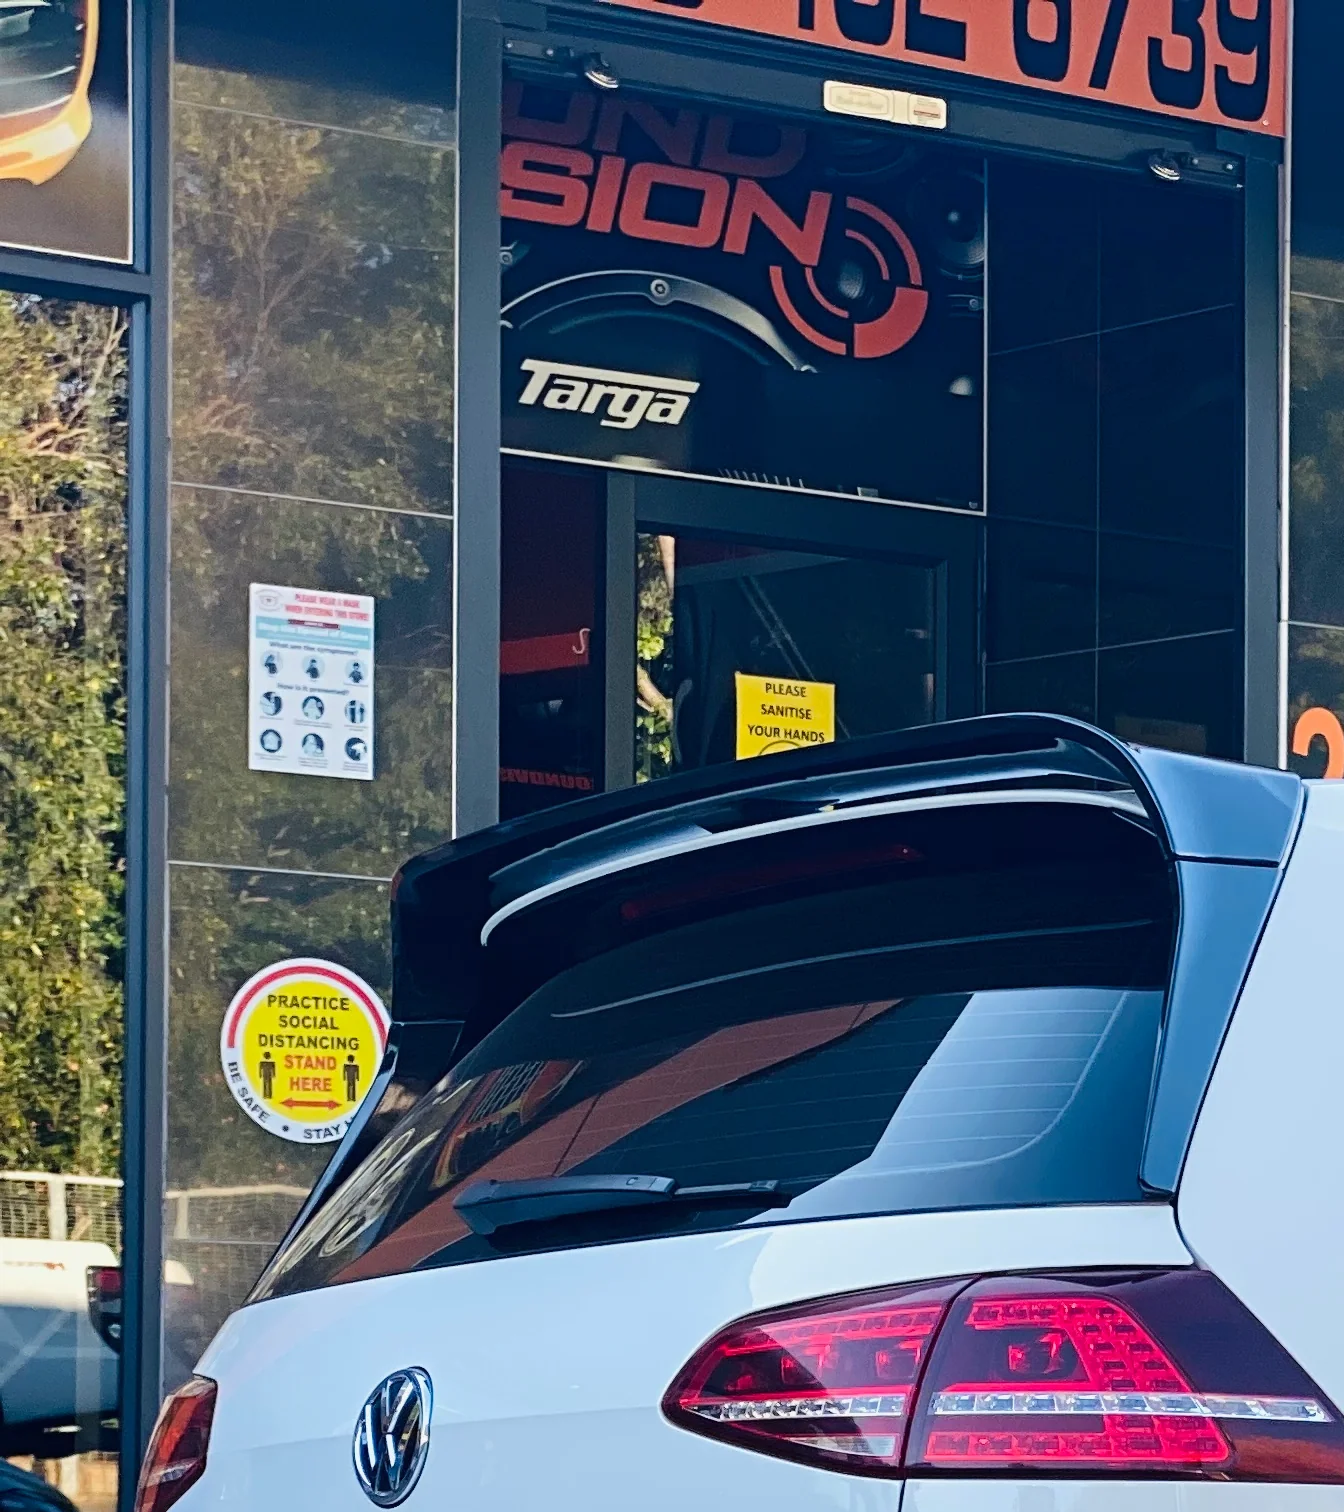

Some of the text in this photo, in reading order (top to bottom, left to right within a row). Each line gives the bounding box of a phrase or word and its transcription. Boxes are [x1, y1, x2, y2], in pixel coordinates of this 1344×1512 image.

[500, 82, 807, 178] UND
[500, 140, 832, 266] SION
[518, 358, 700, 430] Targa
[765, 682, 807, 697] PLEASE
[761, 703, 812, 720] SANITISE
[747, 724, 825, 743] YOUR HANDS
[267, 994, 350, 1011] PRACTICE
[279, 1015, 340, 1030] SOCIAL
[258, 1034, 360, 1051] DISTANCING
[284, 1054, 337, 1070] STAND
[289, 1077, 333, 1092] HERE
[237, 1086, 272, 1123] SAFE
[303, 1123, 341, 1140] STAY
